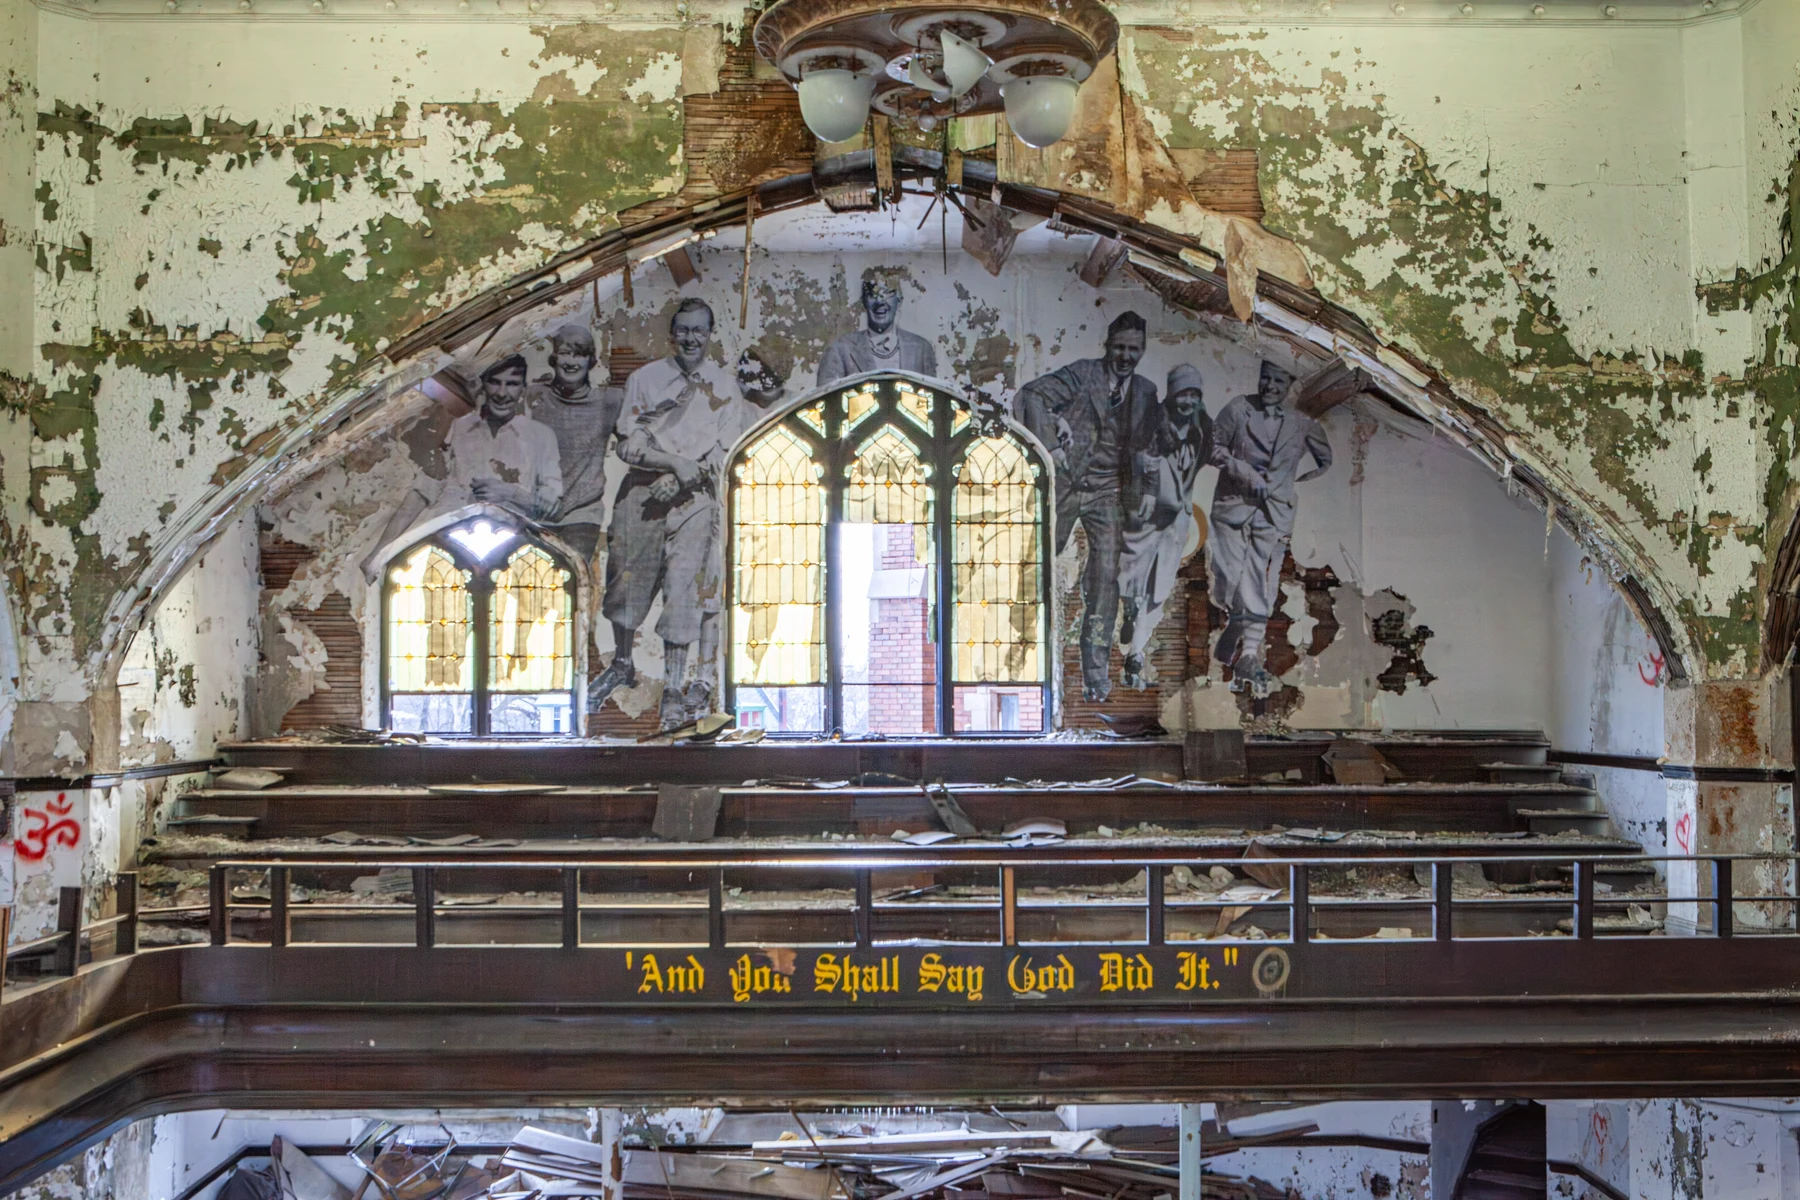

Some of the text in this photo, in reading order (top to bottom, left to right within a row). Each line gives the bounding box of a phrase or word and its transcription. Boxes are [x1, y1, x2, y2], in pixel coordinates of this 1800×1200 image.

[729, 953, 792, 1003] You
[813, 953, 900, 1002] Shall
[918, 952, 985, 1002] Say
[1007, 953, 1075, 993] God
[1099, 952, 1154, 992] Did
[1175, 947, 1239, 992] It."
